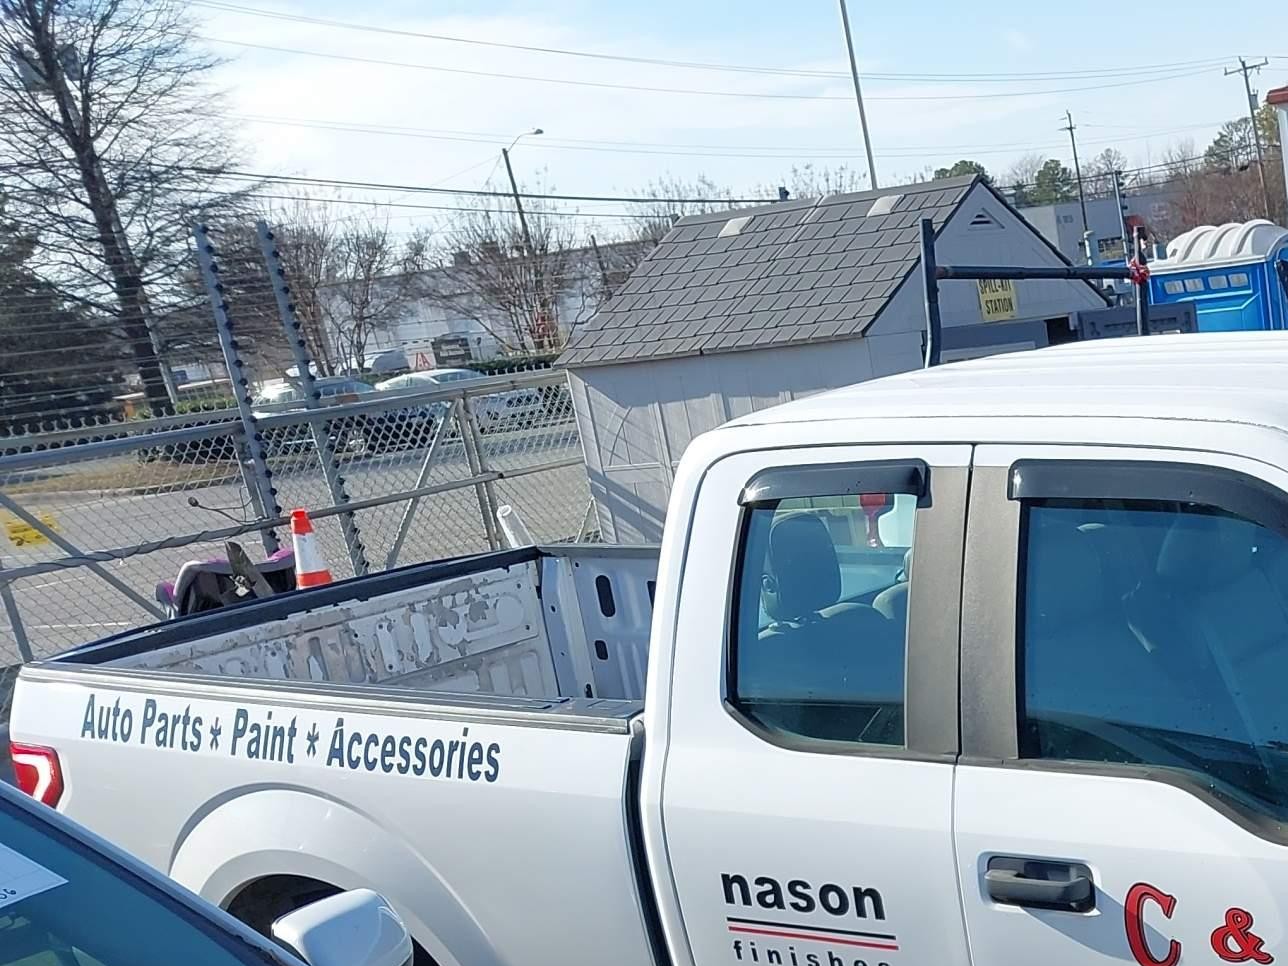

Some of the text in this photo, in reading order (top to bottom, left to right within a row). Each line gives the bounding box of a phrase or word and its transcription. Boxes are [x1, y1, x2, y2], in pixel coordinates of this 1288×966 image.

[985, 297, 1014, 315] STATION
[81, 693, 501, 783] Auto Parts Paint Accessories
[720, 872, 886, 921] nason
[1210, 907, 1274, 965] &
